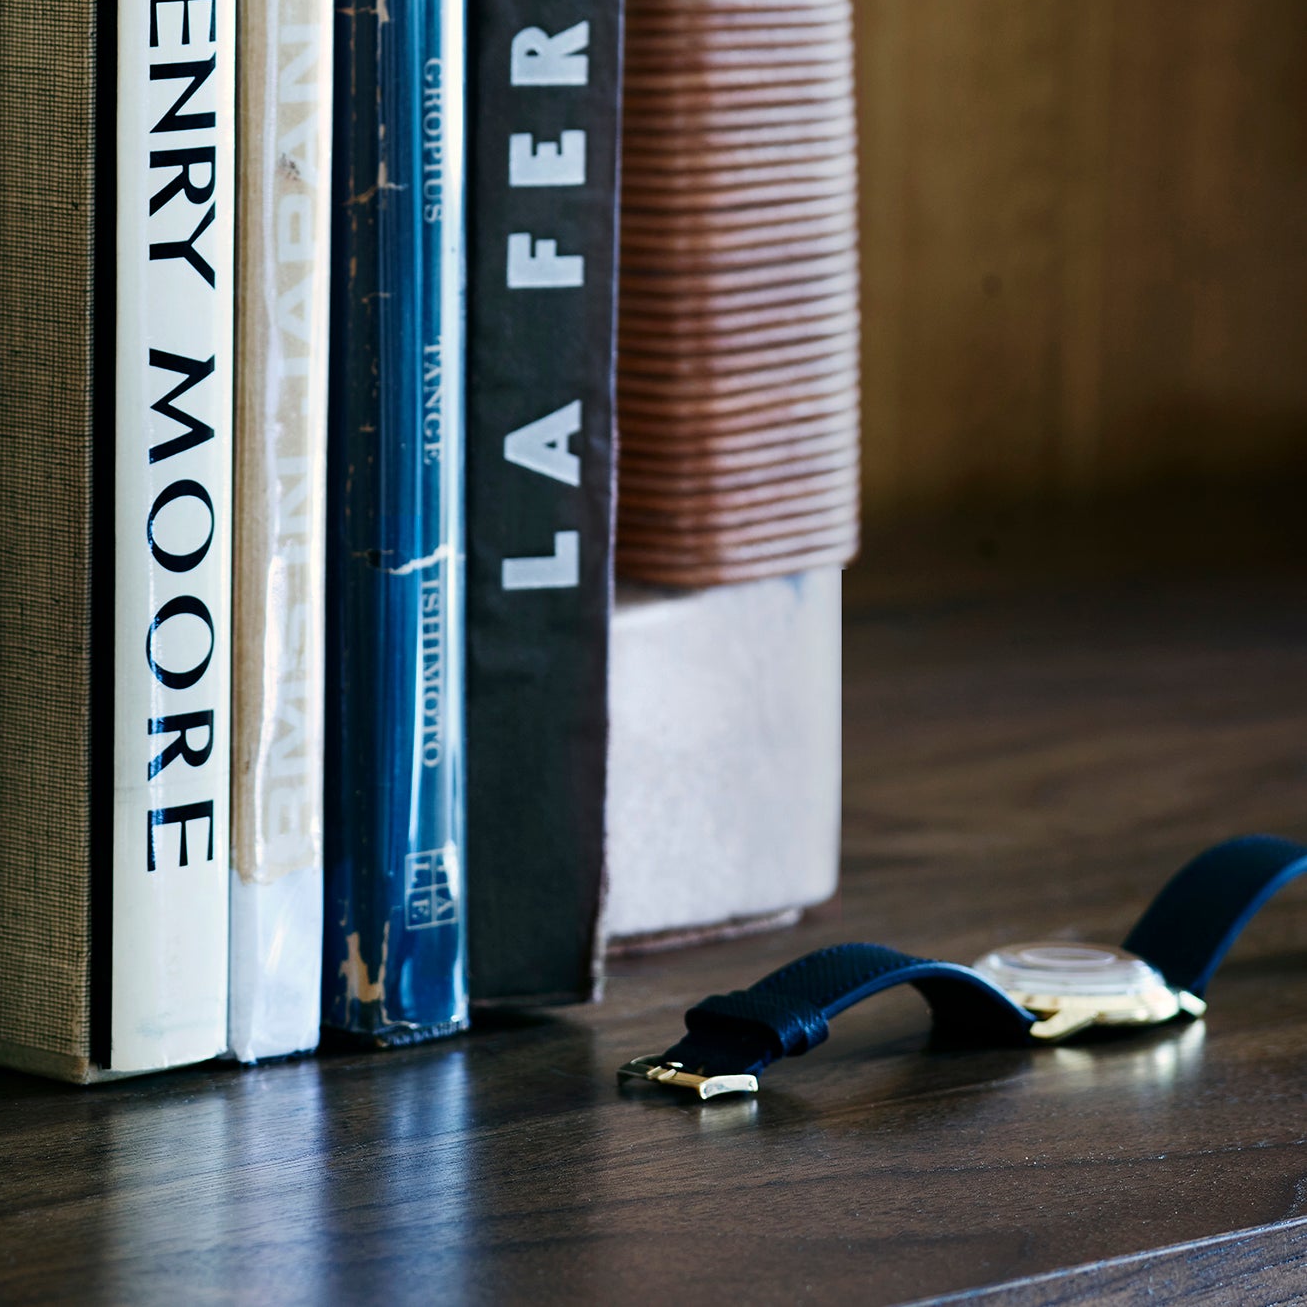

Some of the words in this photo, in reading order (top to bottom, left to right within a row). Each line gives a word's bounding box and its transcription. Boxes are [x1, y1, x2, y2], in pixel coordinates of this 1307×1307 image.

[276, 24, 322, 416] JAPAN
[422, 56, 446, 225] GROPIUS
[423, 335, 446, 466] TANGE
[501, 399, 582, 590] LA
[146, 348, 215, 872] MOORE
[420, 578, 446, 769] ISHIMOTO
